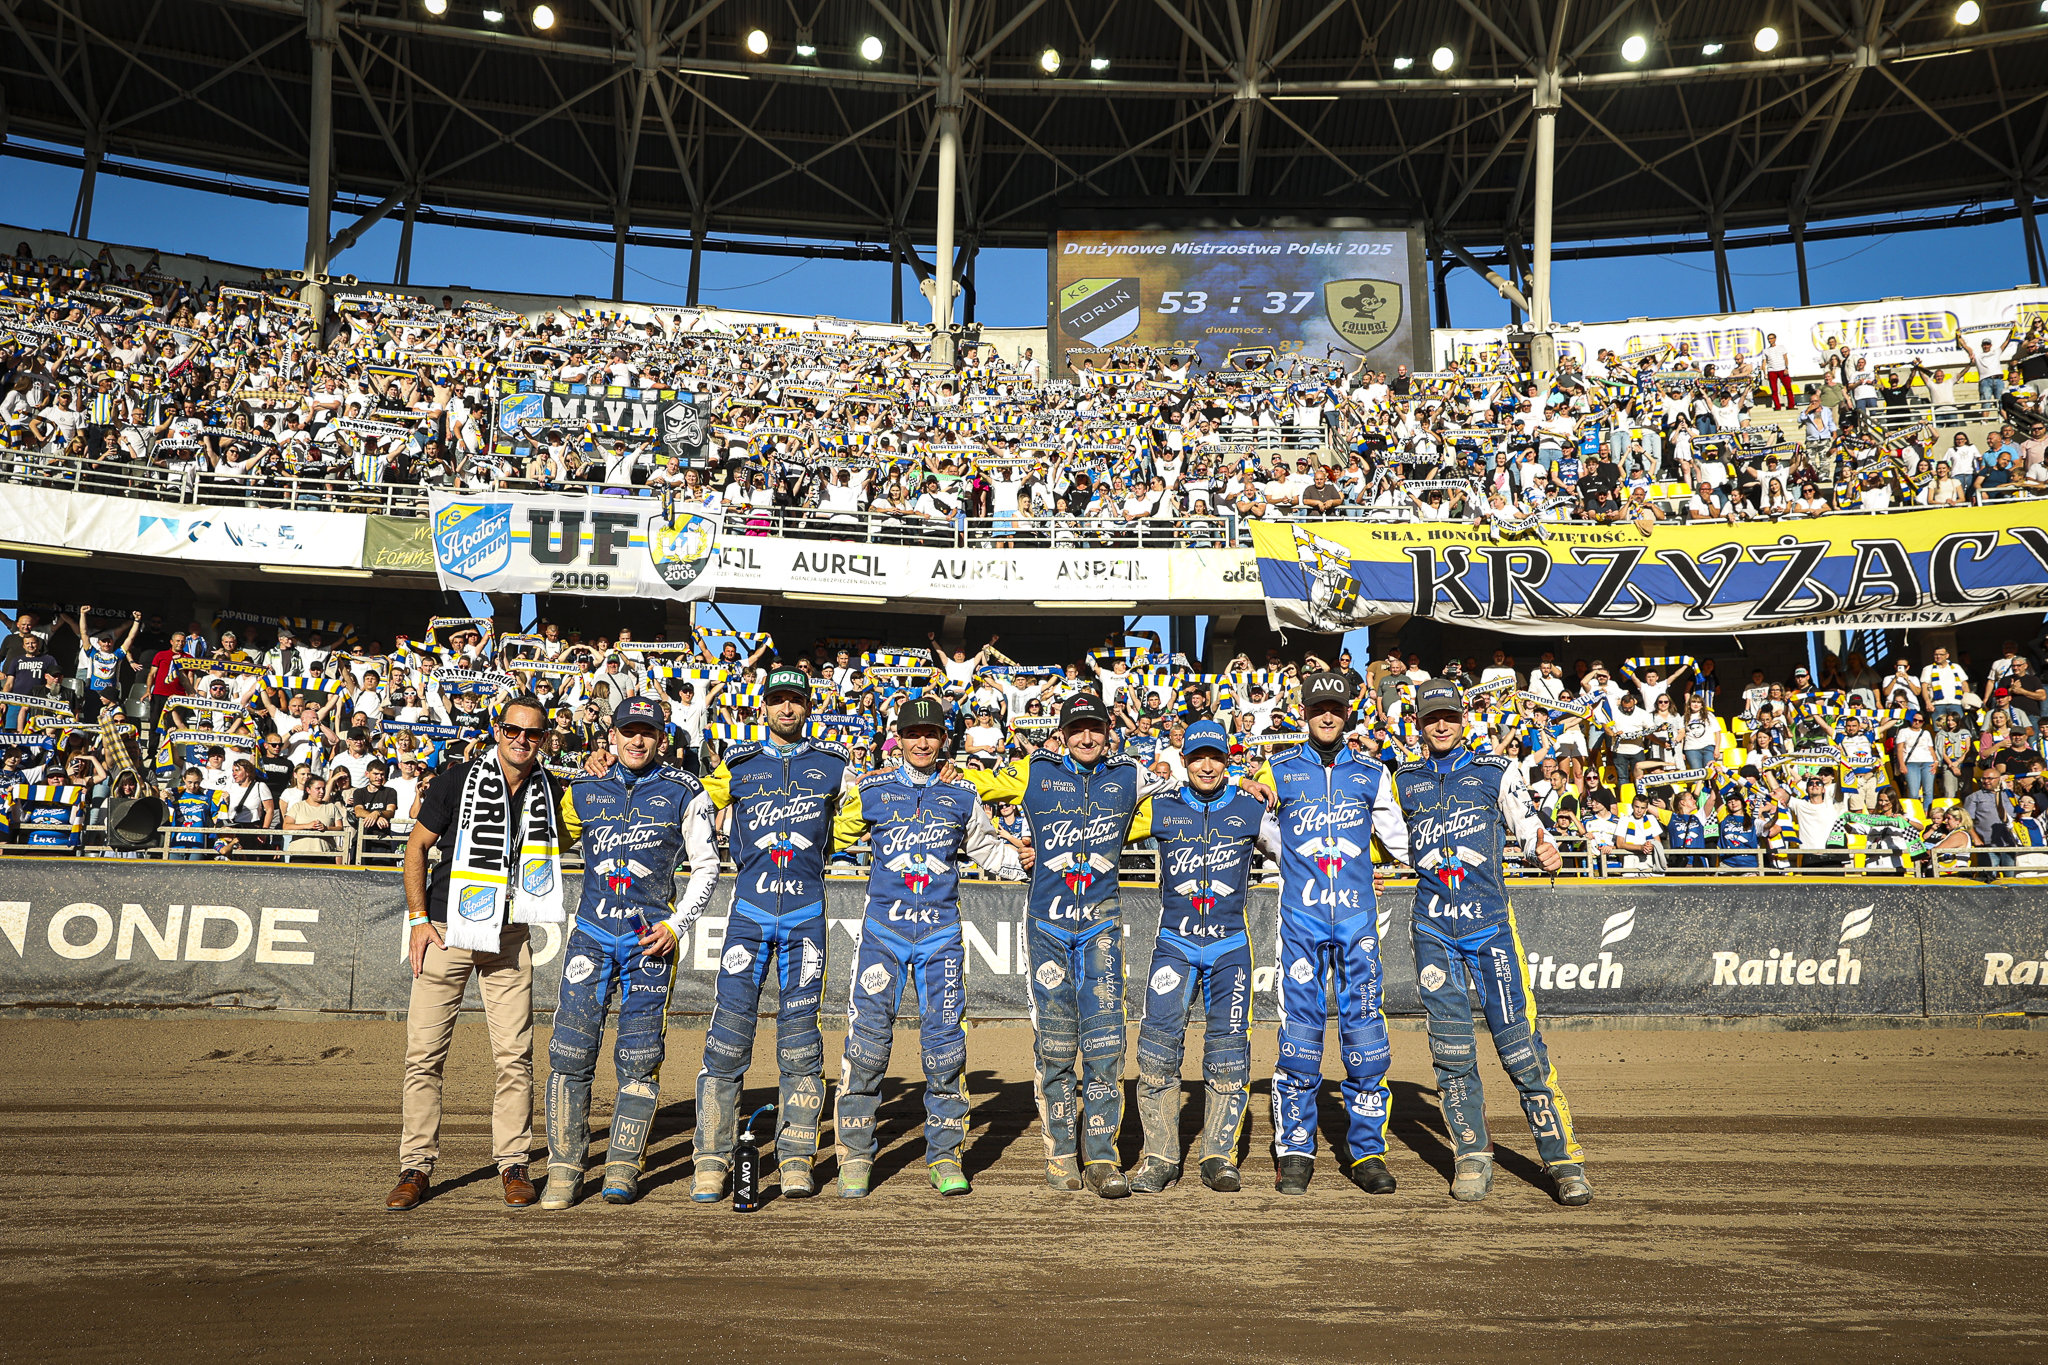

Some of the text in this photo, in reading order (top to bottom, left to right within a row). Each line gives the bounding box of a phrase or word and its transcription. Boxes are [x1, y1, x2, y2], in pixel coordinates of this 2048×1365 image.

[1063, 242, 1393, 257] Drużynowe Mistrzostwa Polski 2025
[1068, 284, 1089, 300] KS
[1157, 292, 1208, 314] 53
[1262, 292, 1315, 314] 37
[1069, 290, 1130, 329] TORUŃ
[1205, 326, 1264, 335] dwumecz
[550, 396, 656, 429] MŁYN
[439, 510, 461, 529] KS
[440, 508, 509, 564] Apator
[526, 507, 640, 567] UF
[1371, 530, 1421, 542] SIŁA,
[663, 570, 698, 581] 2008
[666, 563, 691, 572] since
[550, 571, 611, 592] 2008
[1793, 610, 1957, 628] NAJWAŻNIEJSZA
[771, 672, 803, 685] BOLL
[1312, 677, 1345, 693] AVO
[815, 741, 850, 759] APRO
[1356, 754, 1383, 765] APRO
[1475, 756, 1507, 765] APRO
[665, 771, 700, 791] APRO
[858, 774, 895, 788] CANAL+
[749, 794, 824, 831] Apator
[938, 799, 953, 807] PGE
[1294, 800, 1366, 836] Apator
[1415, 806, 1487, 851] Apator
[593, 820, 659, 856] Apator
[883, 821, 955, 856] Apator
[1045, 813, 1122, 851] Apator
[1170, 841, 1242, 876] Apator
[756, 871, 797, 895] Lux
[1302, 878, 1352, 909] Lux
[596, 898, 640, 920] Lux
[678, 880, 715, 933] NICOLAUS
[888, 899, 932, 924] Lux
[1049, 895, 1095, 921] Lux
[1428, 894, 1474, 919] Lux
[47, 902, 321, 966] ONDE
[1178, 916, 1218, 938] Lux
[1526, 952, 1624, 989] itech
[1713, 946, 1862, 987] Raitech
[631, 984, 667, 993] STALCO
[943, 957, 958, 1010] REXER
[786, 995, 818, 1009] Furnisol
[550, 1073, 560, 1118] Grohmann
[787, 1093, 820, 1109] AVO
[1529, 1094, 1561, 1141] FST
[621, 1122, 640, 1136] MU
[617, 1134, 637, 1148] RA
[742, 1160, 751, 1184] AVO
